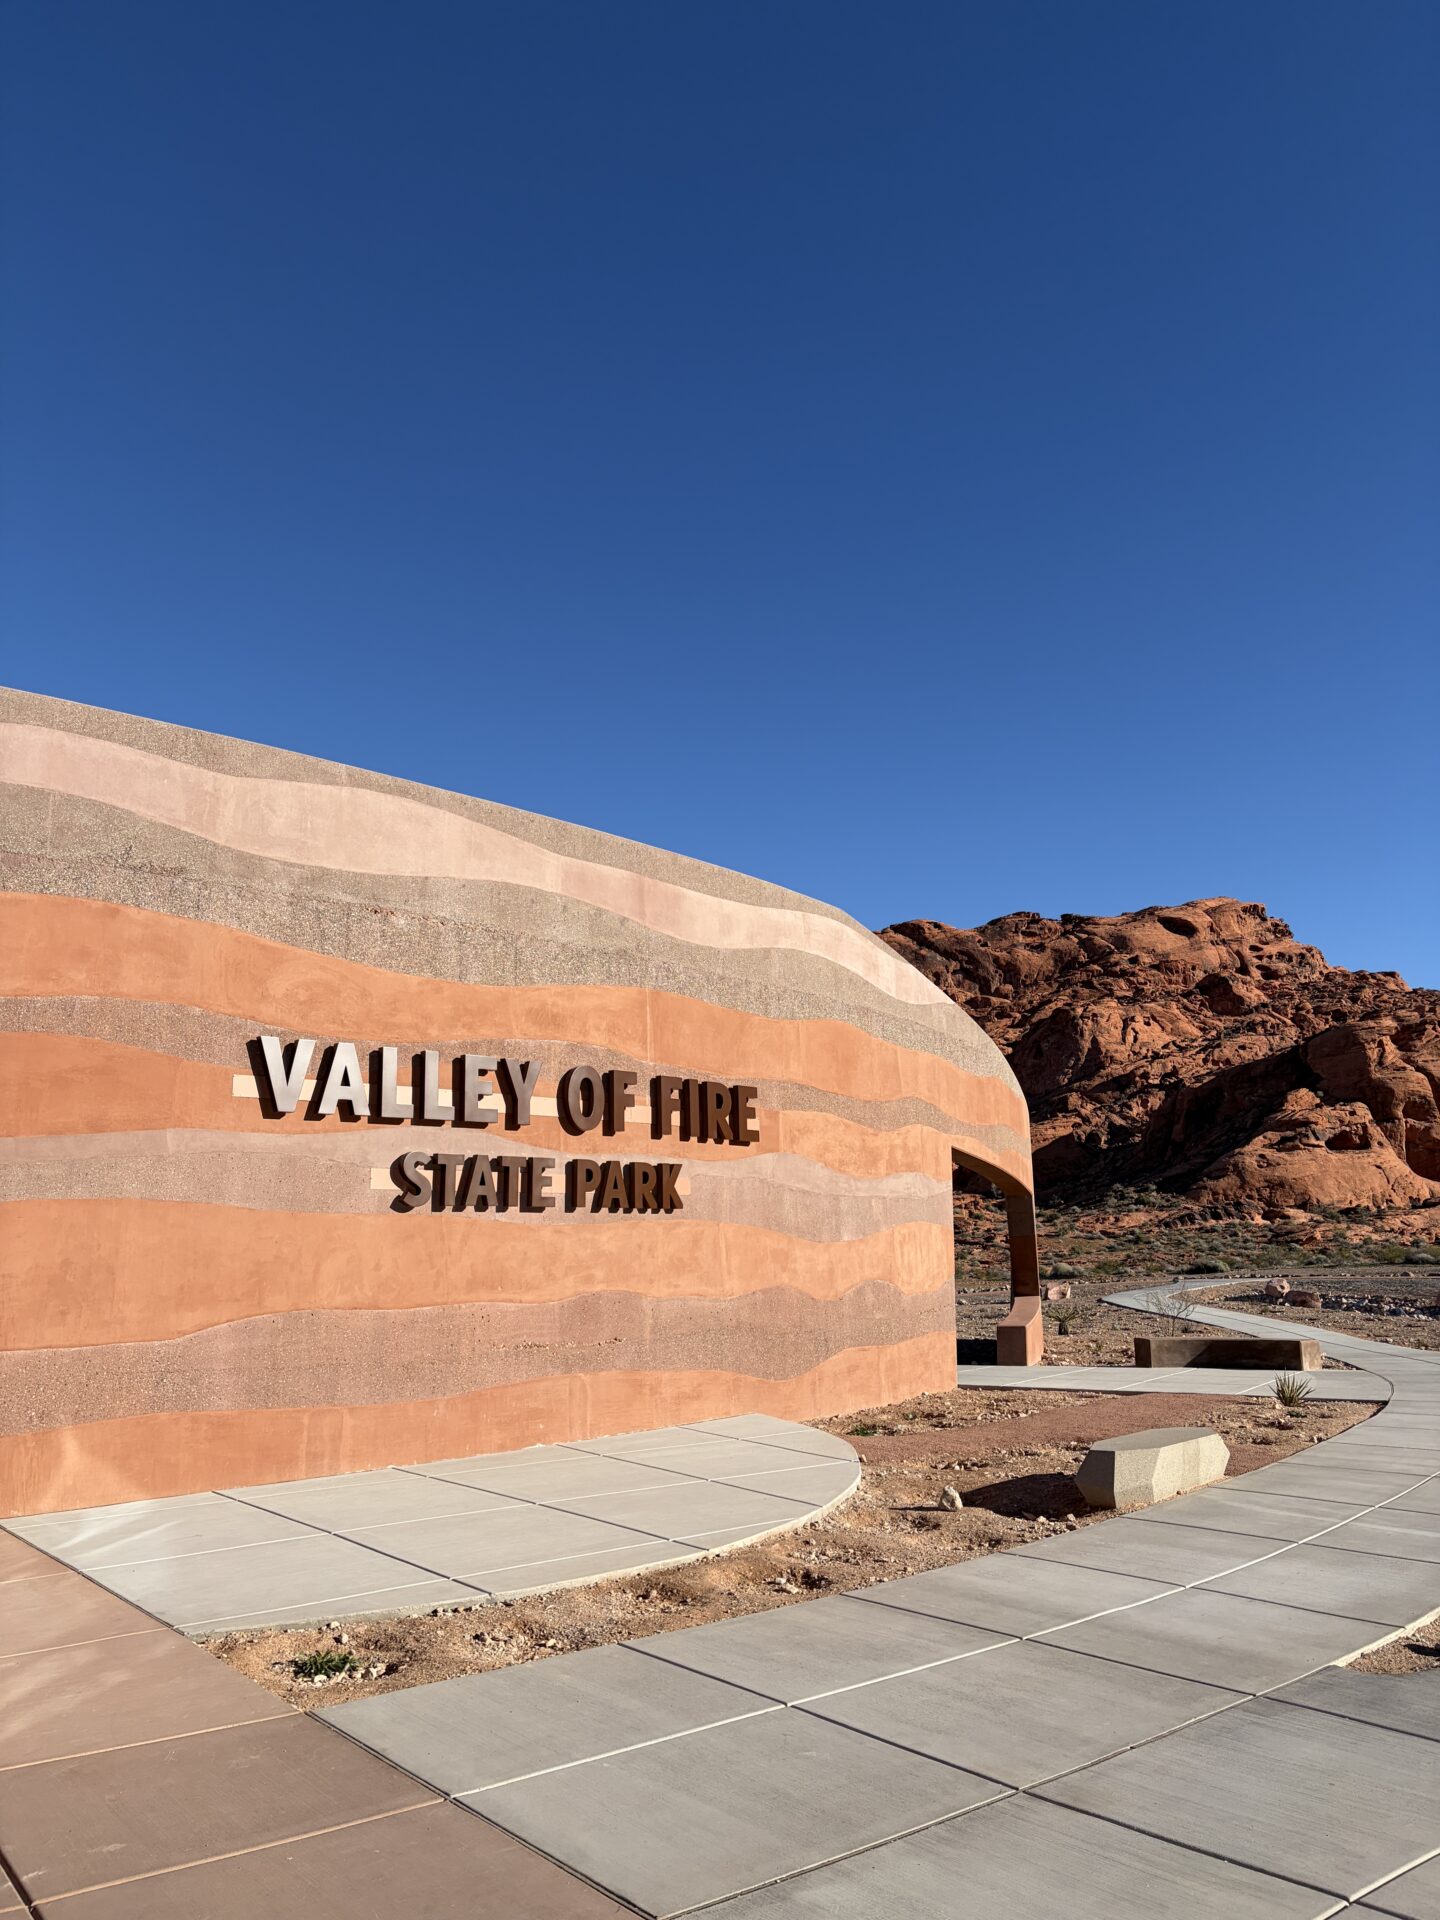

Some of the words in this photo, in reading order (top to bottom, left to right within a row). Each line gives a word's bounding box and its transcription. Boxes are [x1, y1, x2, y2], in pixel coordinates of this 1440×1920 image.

[259, 1035, 543, 1125] VALLEY
[566, 1064, 638, 1132] OF
[659, 1075, 760, 1143] FIRE
[402, 1151, 556, 1207] STATE
[575, 1158, 684, 1210] PARK
